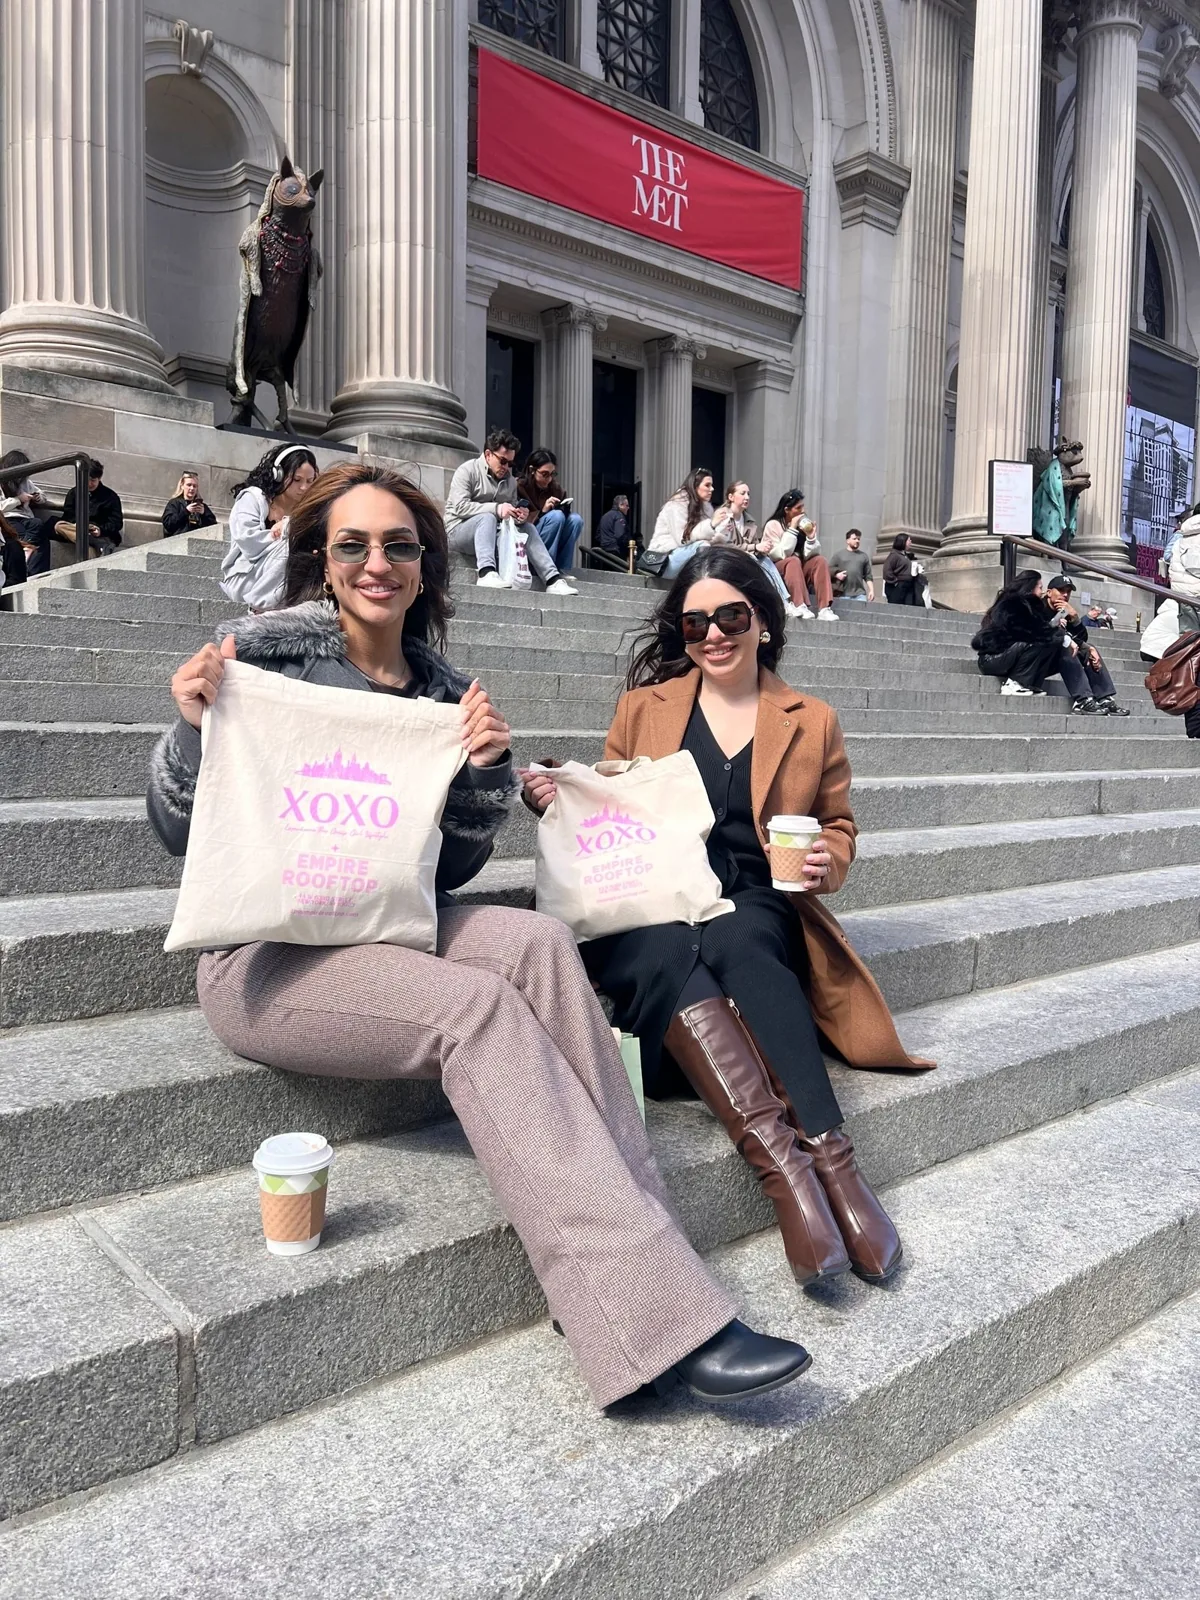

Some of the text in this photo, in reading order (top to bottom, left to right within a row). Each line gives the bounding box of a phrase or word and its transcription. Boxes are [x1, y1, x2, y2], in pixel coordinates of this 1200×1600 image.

[631, 134, 688, 191] THE
[631, 174, 689, 232] MET
[1136, 555, 1156, 570] FROM
[278, 786, 400, 829] XOXO
[575, 826, 657, 857] XOXO
[297, 853, 369, 877] EMPIRE
[583, 863, 654, 886] ROOFTOP
[592, 855, 643, 874] EMPIRE
[282, 869, 378, 894] ROOFTOP
